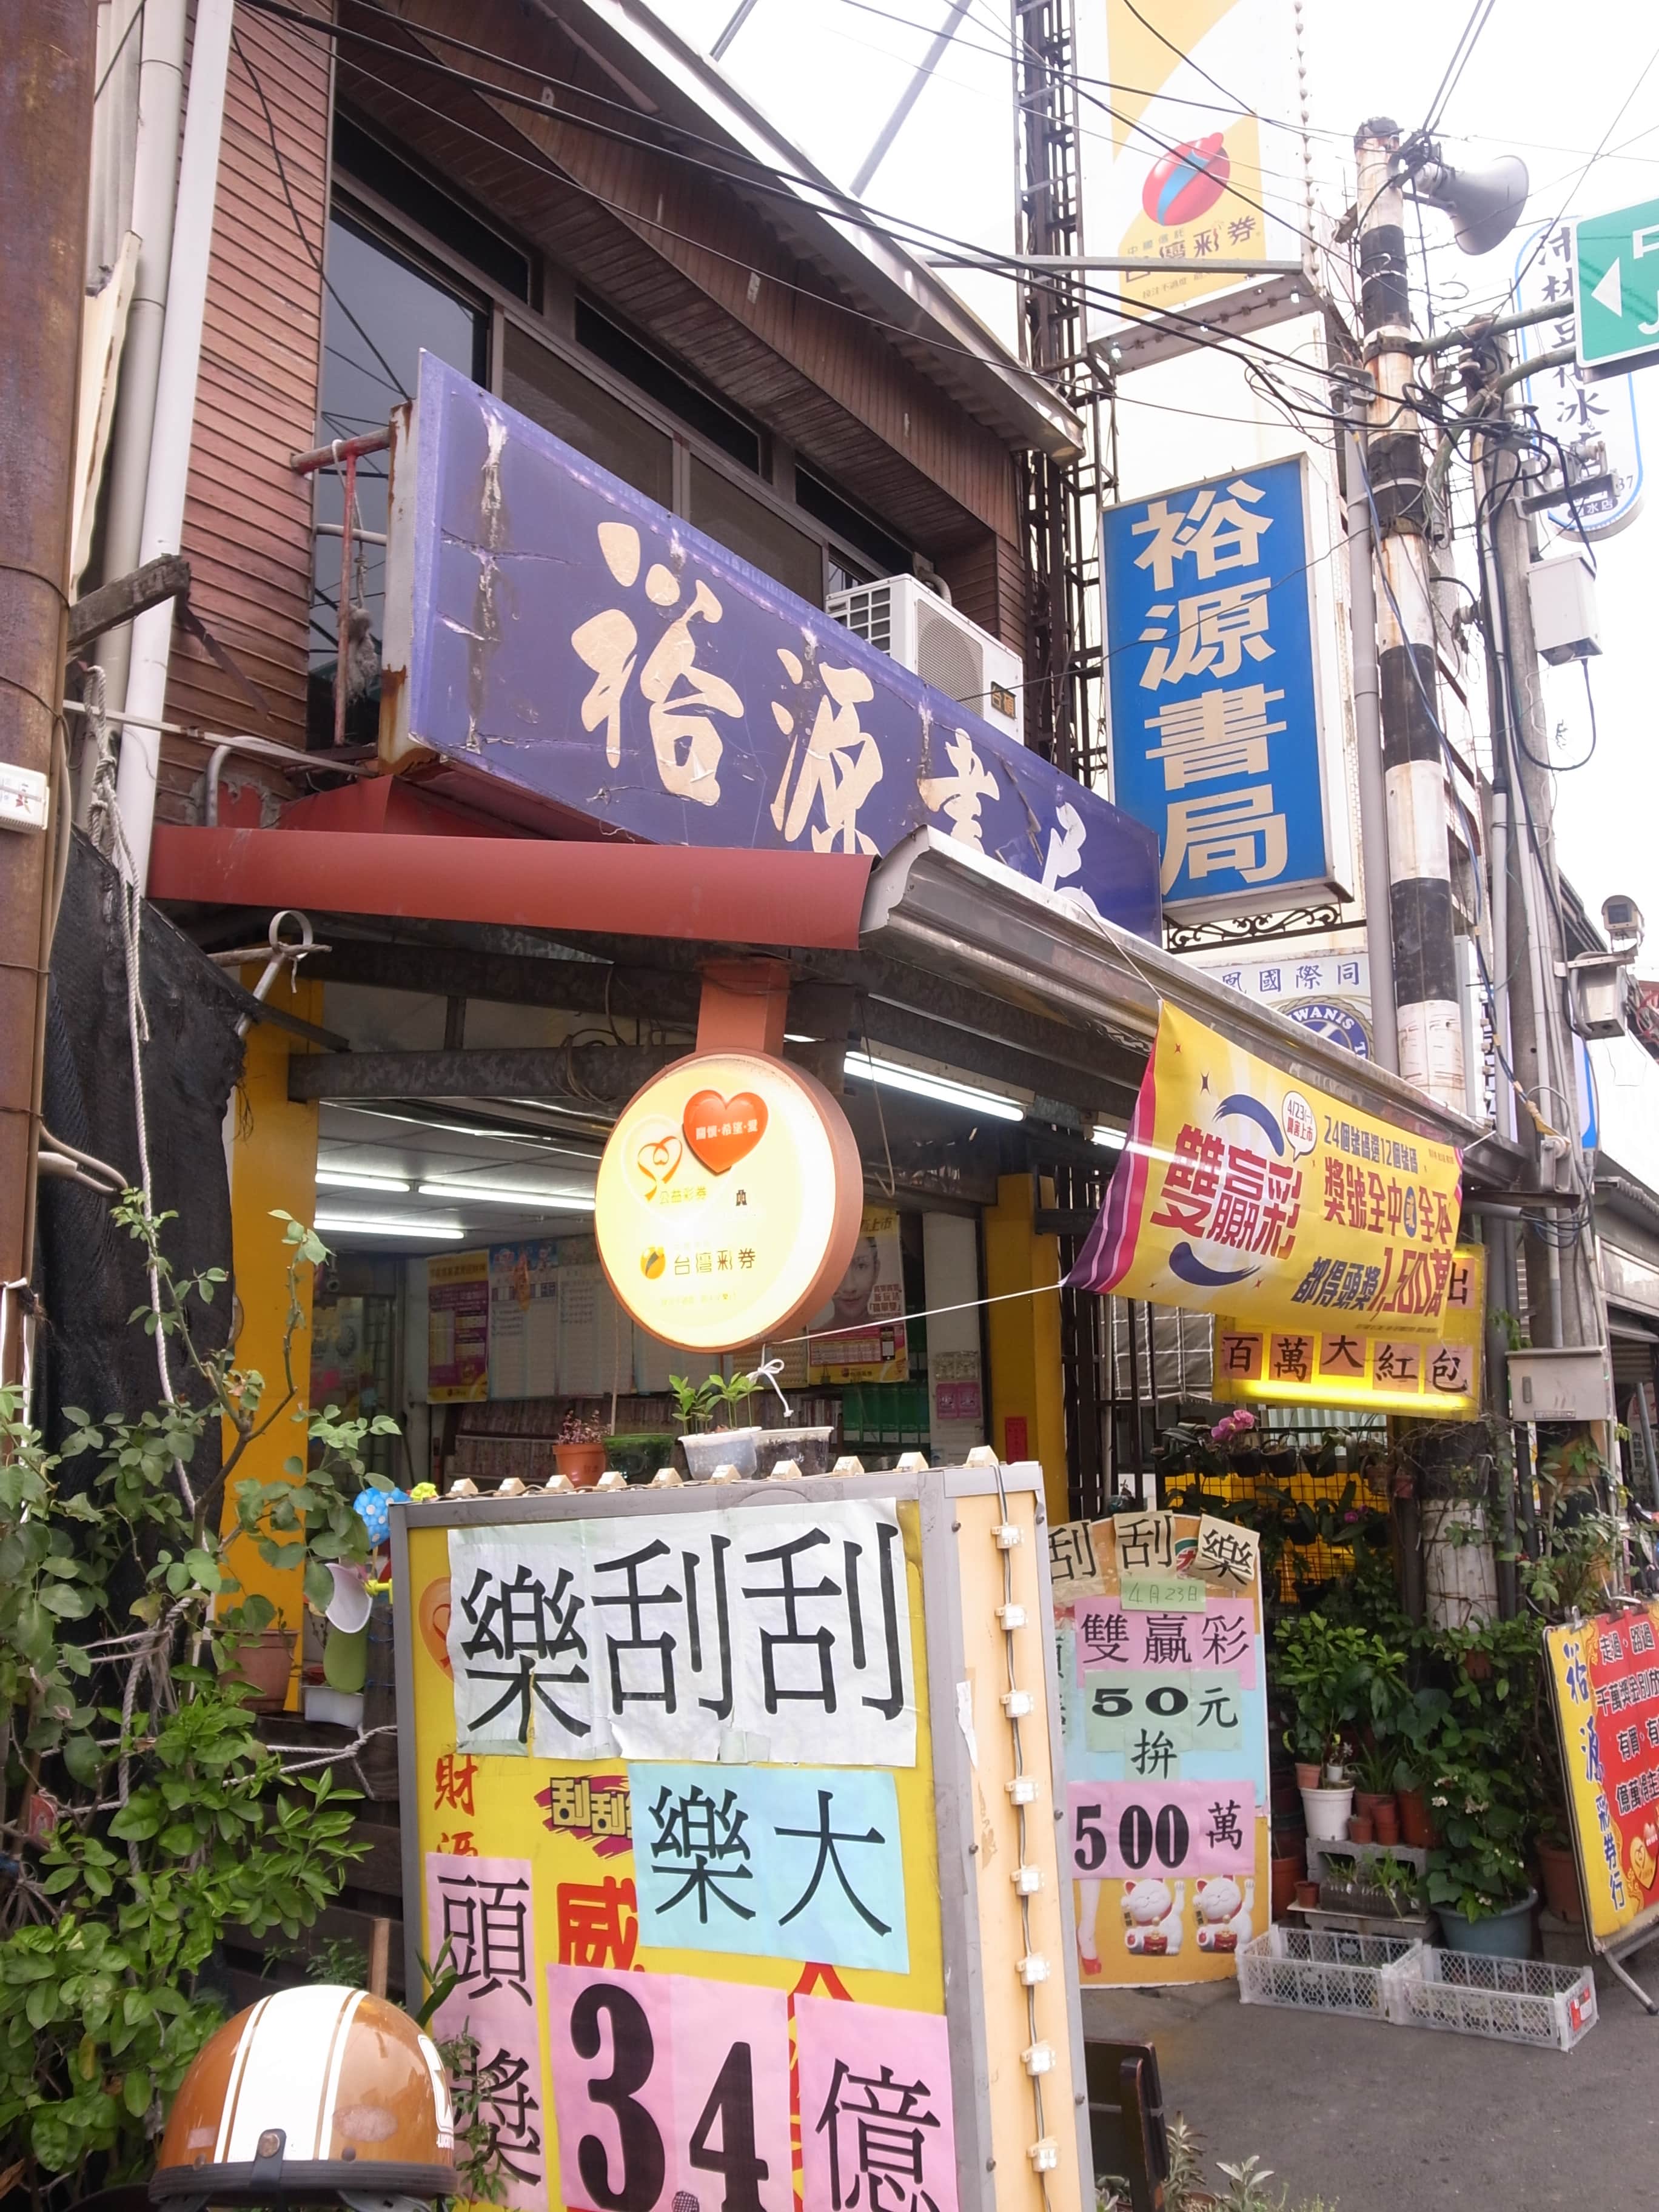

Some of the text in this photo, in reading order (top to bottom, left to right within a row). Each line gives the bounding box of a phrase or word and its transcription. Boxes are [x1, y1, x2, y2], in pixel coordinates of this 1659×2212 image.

[1131, 479, 1288, 896] 裕源書局
[1150, 1124, 1302, 1259] 雙贏彩
[1222, 1335, 1468, 1393] 百萬大紅包
[1128, 1583, 1198, 1604] 4月23日
[1081, 1614, 1249, 1665] 雙贏彩
[1092, 1687, 1238, 1728] 50元
[1074, 1798, 1243, 1871] 500萬
